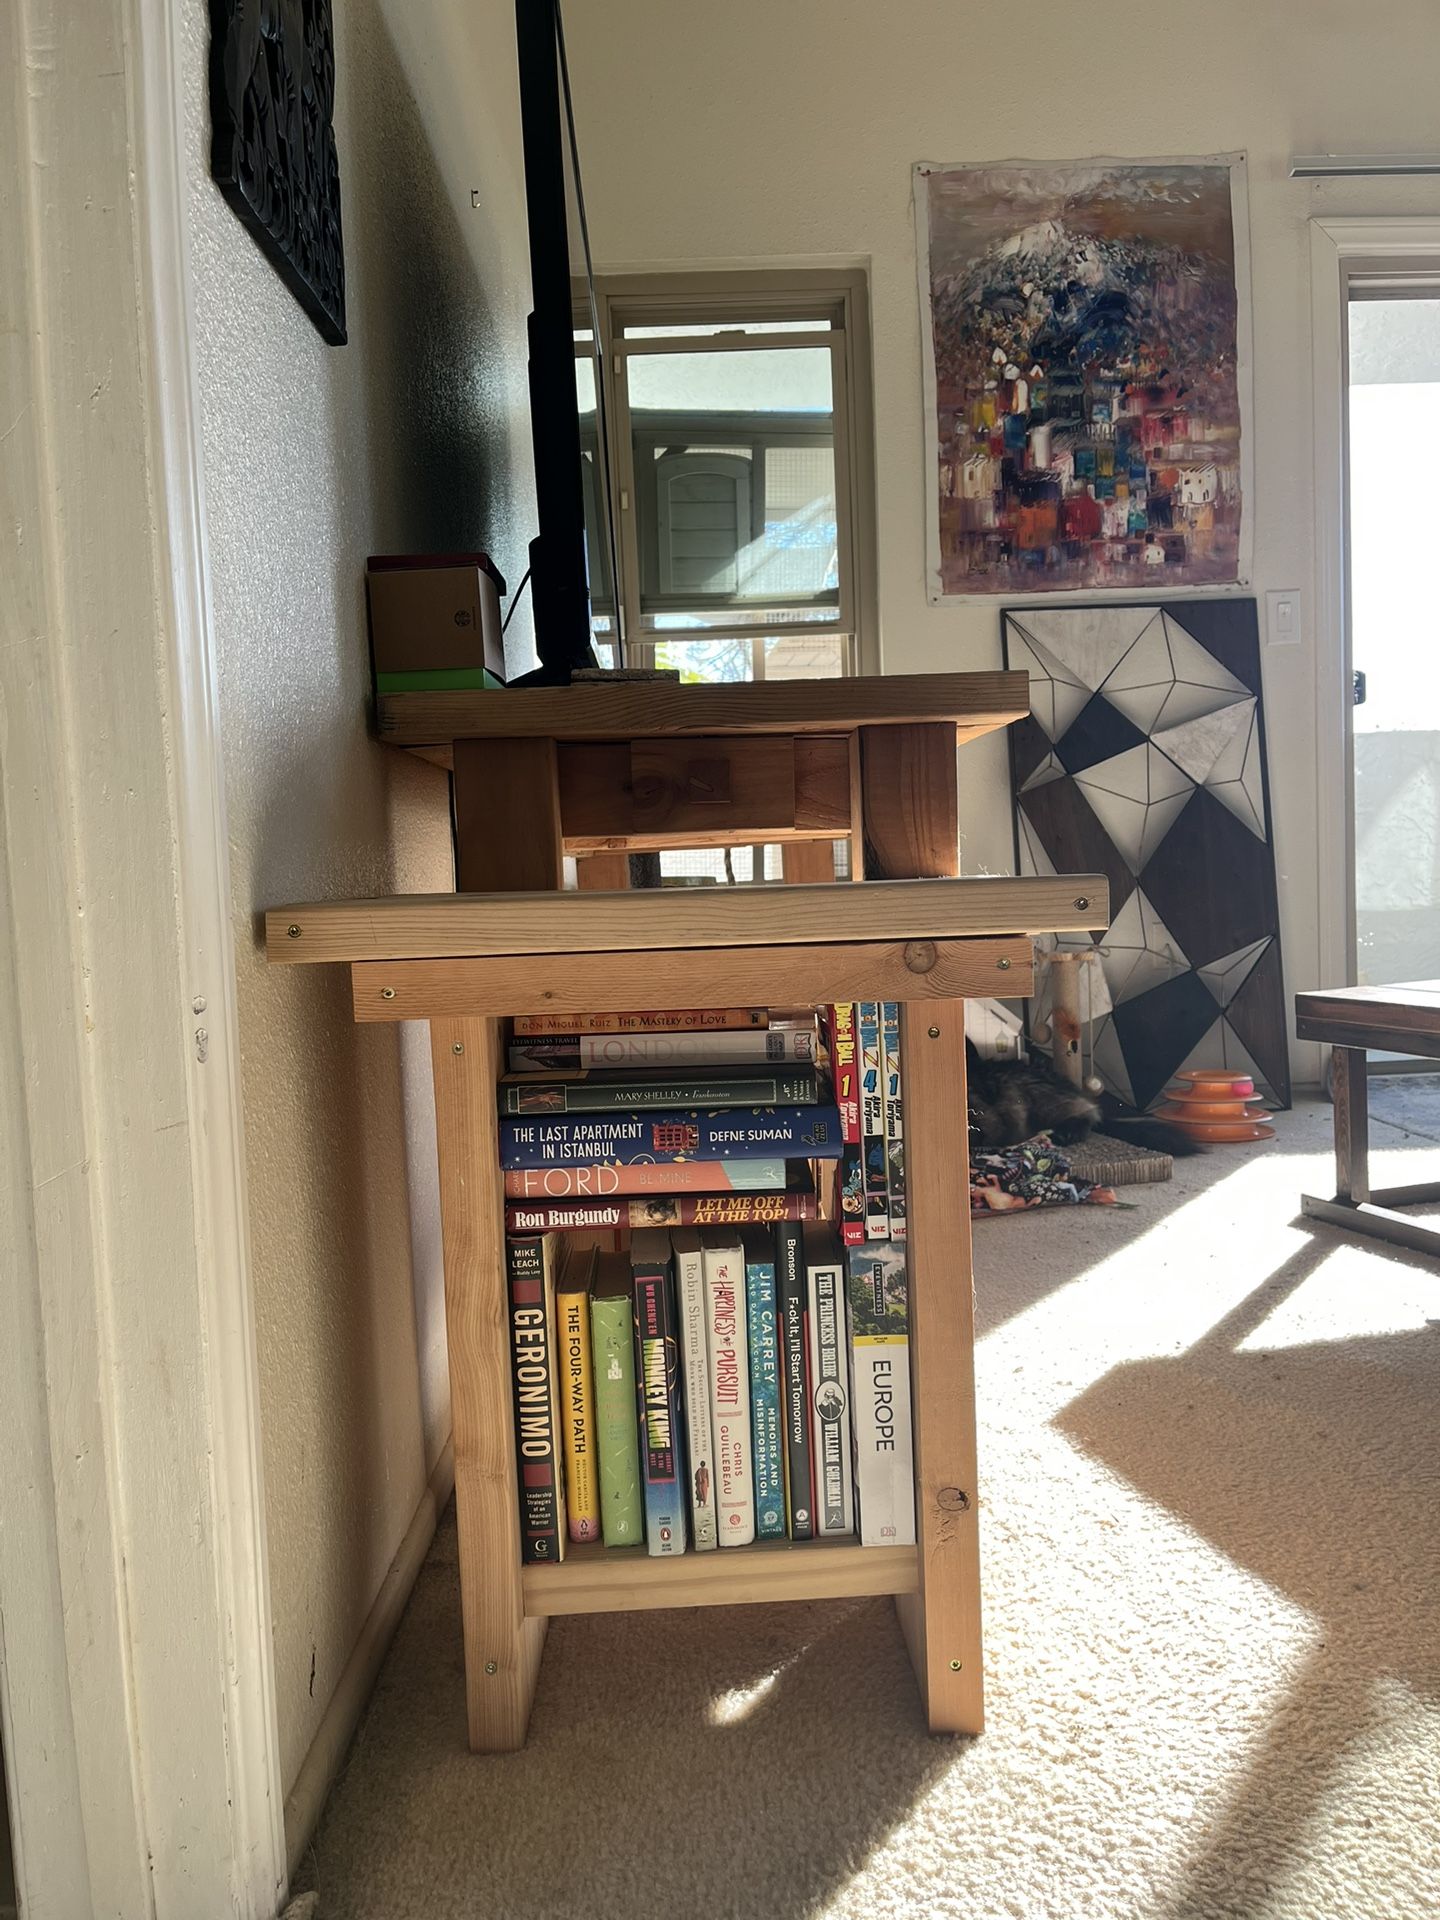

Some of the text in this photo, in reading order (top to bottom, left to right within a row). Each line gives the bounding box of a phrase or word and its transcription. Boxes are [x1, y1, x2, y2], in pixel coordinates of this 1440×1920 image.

[618, 1017, 636, 1027] THE
[639, 1016, 682, 1026] MASTERY
[685, 1016, 697, 1025] OF
[701, 1014, 727, 1025] LOVE
[512, 1036, 578, 1046] EYEWITNESS TRAVEL
[860, 1027, 878, 1050] BALL
[883, 1032, 899, 1054] BALL
[835, 1041, 855, 1067] BALL
[863, 1049, 879, 1069] Z
[886, 1053, 901, 1074] Z
[841, 1074, 850, 1098] 1
[863, 1069, 877, 1093] 4
[889, 1073, 899, 1096] 1
[615, 1091, 642, 1101] MARY
[643, 1090, 682, 1100] SHELLEY
[872, 1095, 882, 1119] Akira
[839, 1101, 849, 1141] Toriyama
[848, 1100, 858, 1125] Akira
[864, 1096, 874, 1135] Toriyama
[886, 1099, 896, 1138] Toriyama
[513, 1123, 644, 1143] THE LAST APARTMENT
[709, 1128, 793, 1143] DEFNE SUMAN
[542, 1141, 616, 1159] IN ISTANBUL
[524, 1166, 619, 1198] FORD
[639, 1171, 692, 1185] BE MINE
[695, 1198, 727, 1212] LET
[727, 1197, 752, 1211] ME
[754, 1195, 786, 1210] OFF
[514, 1207, 621, 1228] Ron Burgundy
[693, 1208, 789, 1224] AT THE TOP!
[512, 1259, 540, 1268] LEACH
[514, 1248, 536, 1258] MIKE
[787, 1238, 797, 1281] Bronson
[718, 1265, 728, 1279] THE
[645, 1284, 655, 1297] WU
[874, 1265, 883, 1314] EYEWITNESS
[686, 1262, 701, 1355] Robin Sharma
[710, 1281, 736, 1337] HAPPINESS
[748, 1275, 760, 1378] AND DANA VACHON
[759, 1272, 775, 1383] JIM CARREY
[789, 1325, 800, 1338] It,
[818, 1274, 837, 1378] THE PRINCESS BRIDE
[790, 1339, 801, 1352] I'll
[567, 1305, 587, 1454] THE FOUR-WAY PATH
[716, 1349, 739, 1405] PURSUIT
[790, 1353, 802, 1384] Start
[513, 1308, 551, 1458] GERONIMO
[642, 1338, 671, 1449] MONKEY KING
[792, 1384, 803, 1444] Tomorrow
[872, 1360, 895, 1452] EUROPE
[756, 1399, 768, 1498] MISINFORMATION
[767, 1407, 779, 1487] MEMOIRS AND
[720, 1425, 732, 1495] GUILLEBEAU
[733, 1442, 743, 1477] CHRIS
[824, 1422, 842, 1508] WILLIAM GOLDMAN
[881, 1527, 896, 1537] DK
